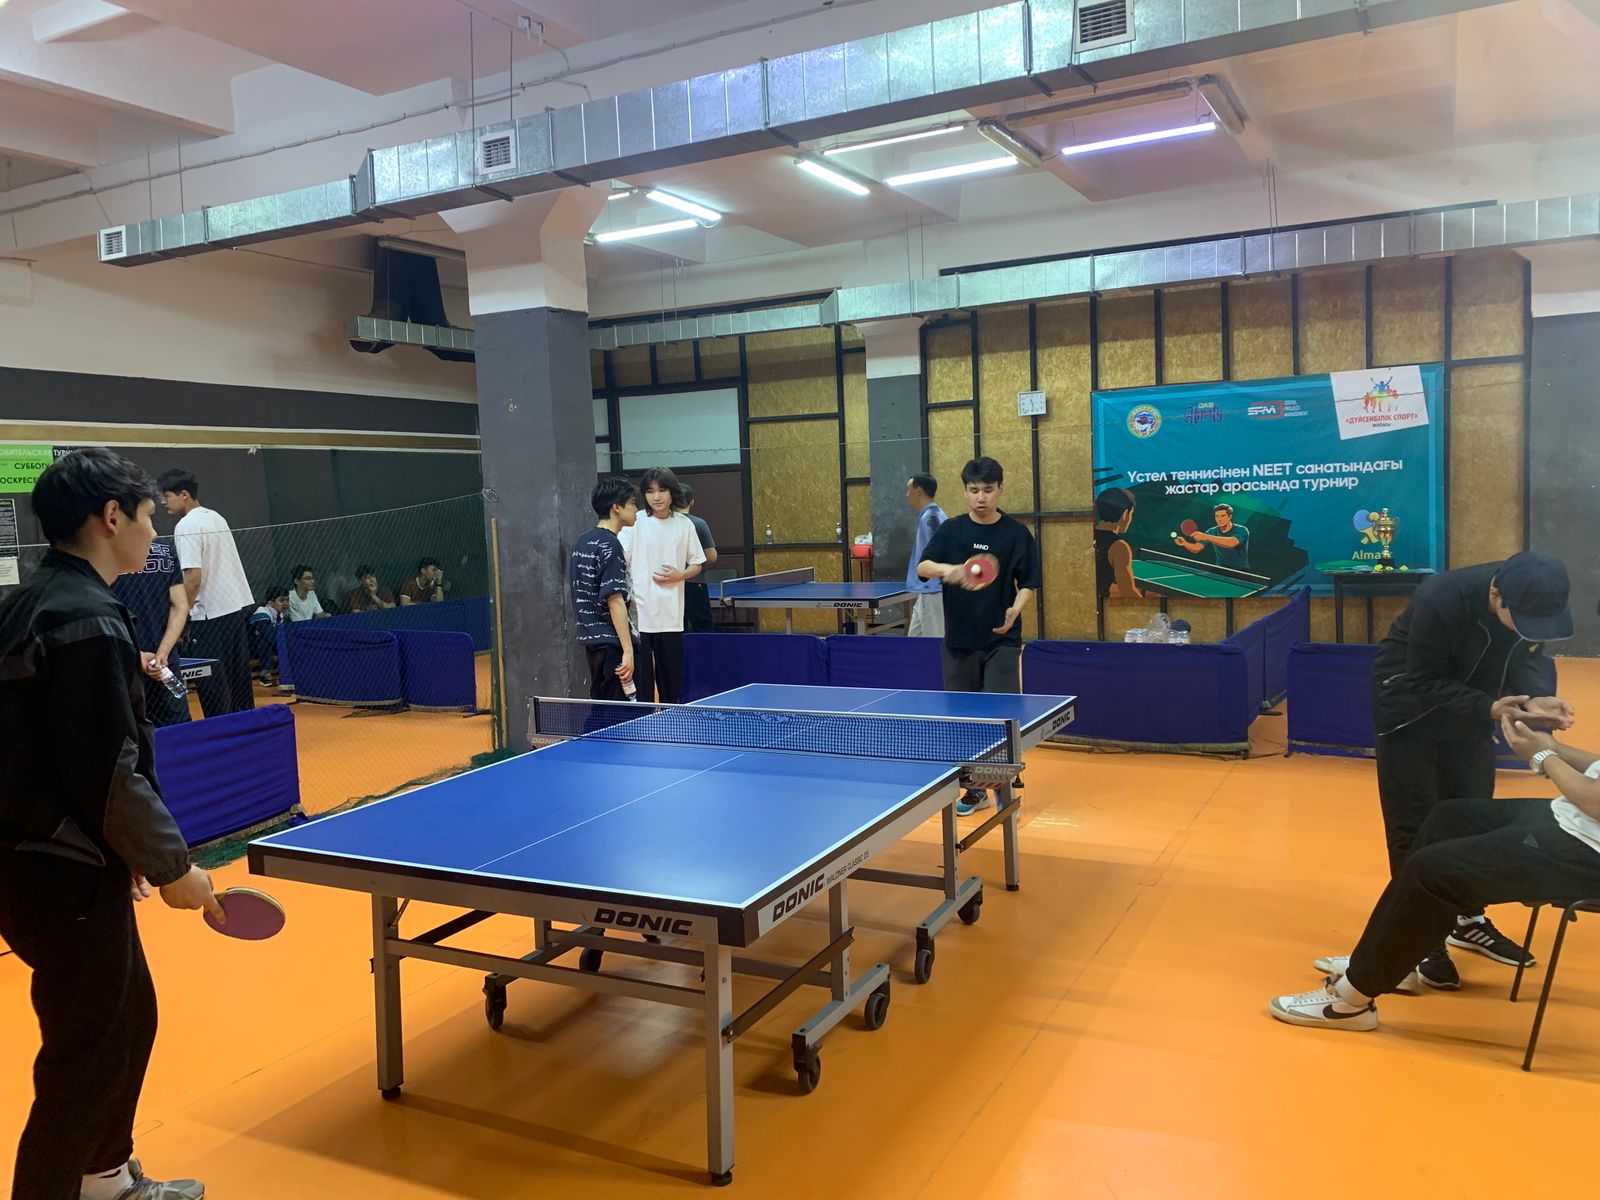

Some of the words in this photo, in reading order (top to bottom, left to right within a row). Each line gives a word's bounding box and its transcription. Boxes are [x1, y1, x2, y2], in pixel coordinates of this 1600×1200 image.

[1127, 471, 1168, 483] Үстел
[1170, 466, 1250, 480] теннисінен
[1252, 462, 1293, 477] NEET
[1296, 459, 1403, 475] санатындағы
[1165, 482, 1219, 495] жастар
[1222, 479, 1300, 494] арасында
[1302, 477, 1359, 491] турнир
[1352, 550, 1381, 560] Alma
[182, 669, 203, 679] NIC
[1052, 711, 1071, 730] DONIC
[975, 766, 1015, 775] DONIC
[773, 873, 825, 922] DONIC
[594, 907, 693, 936] DONIC
